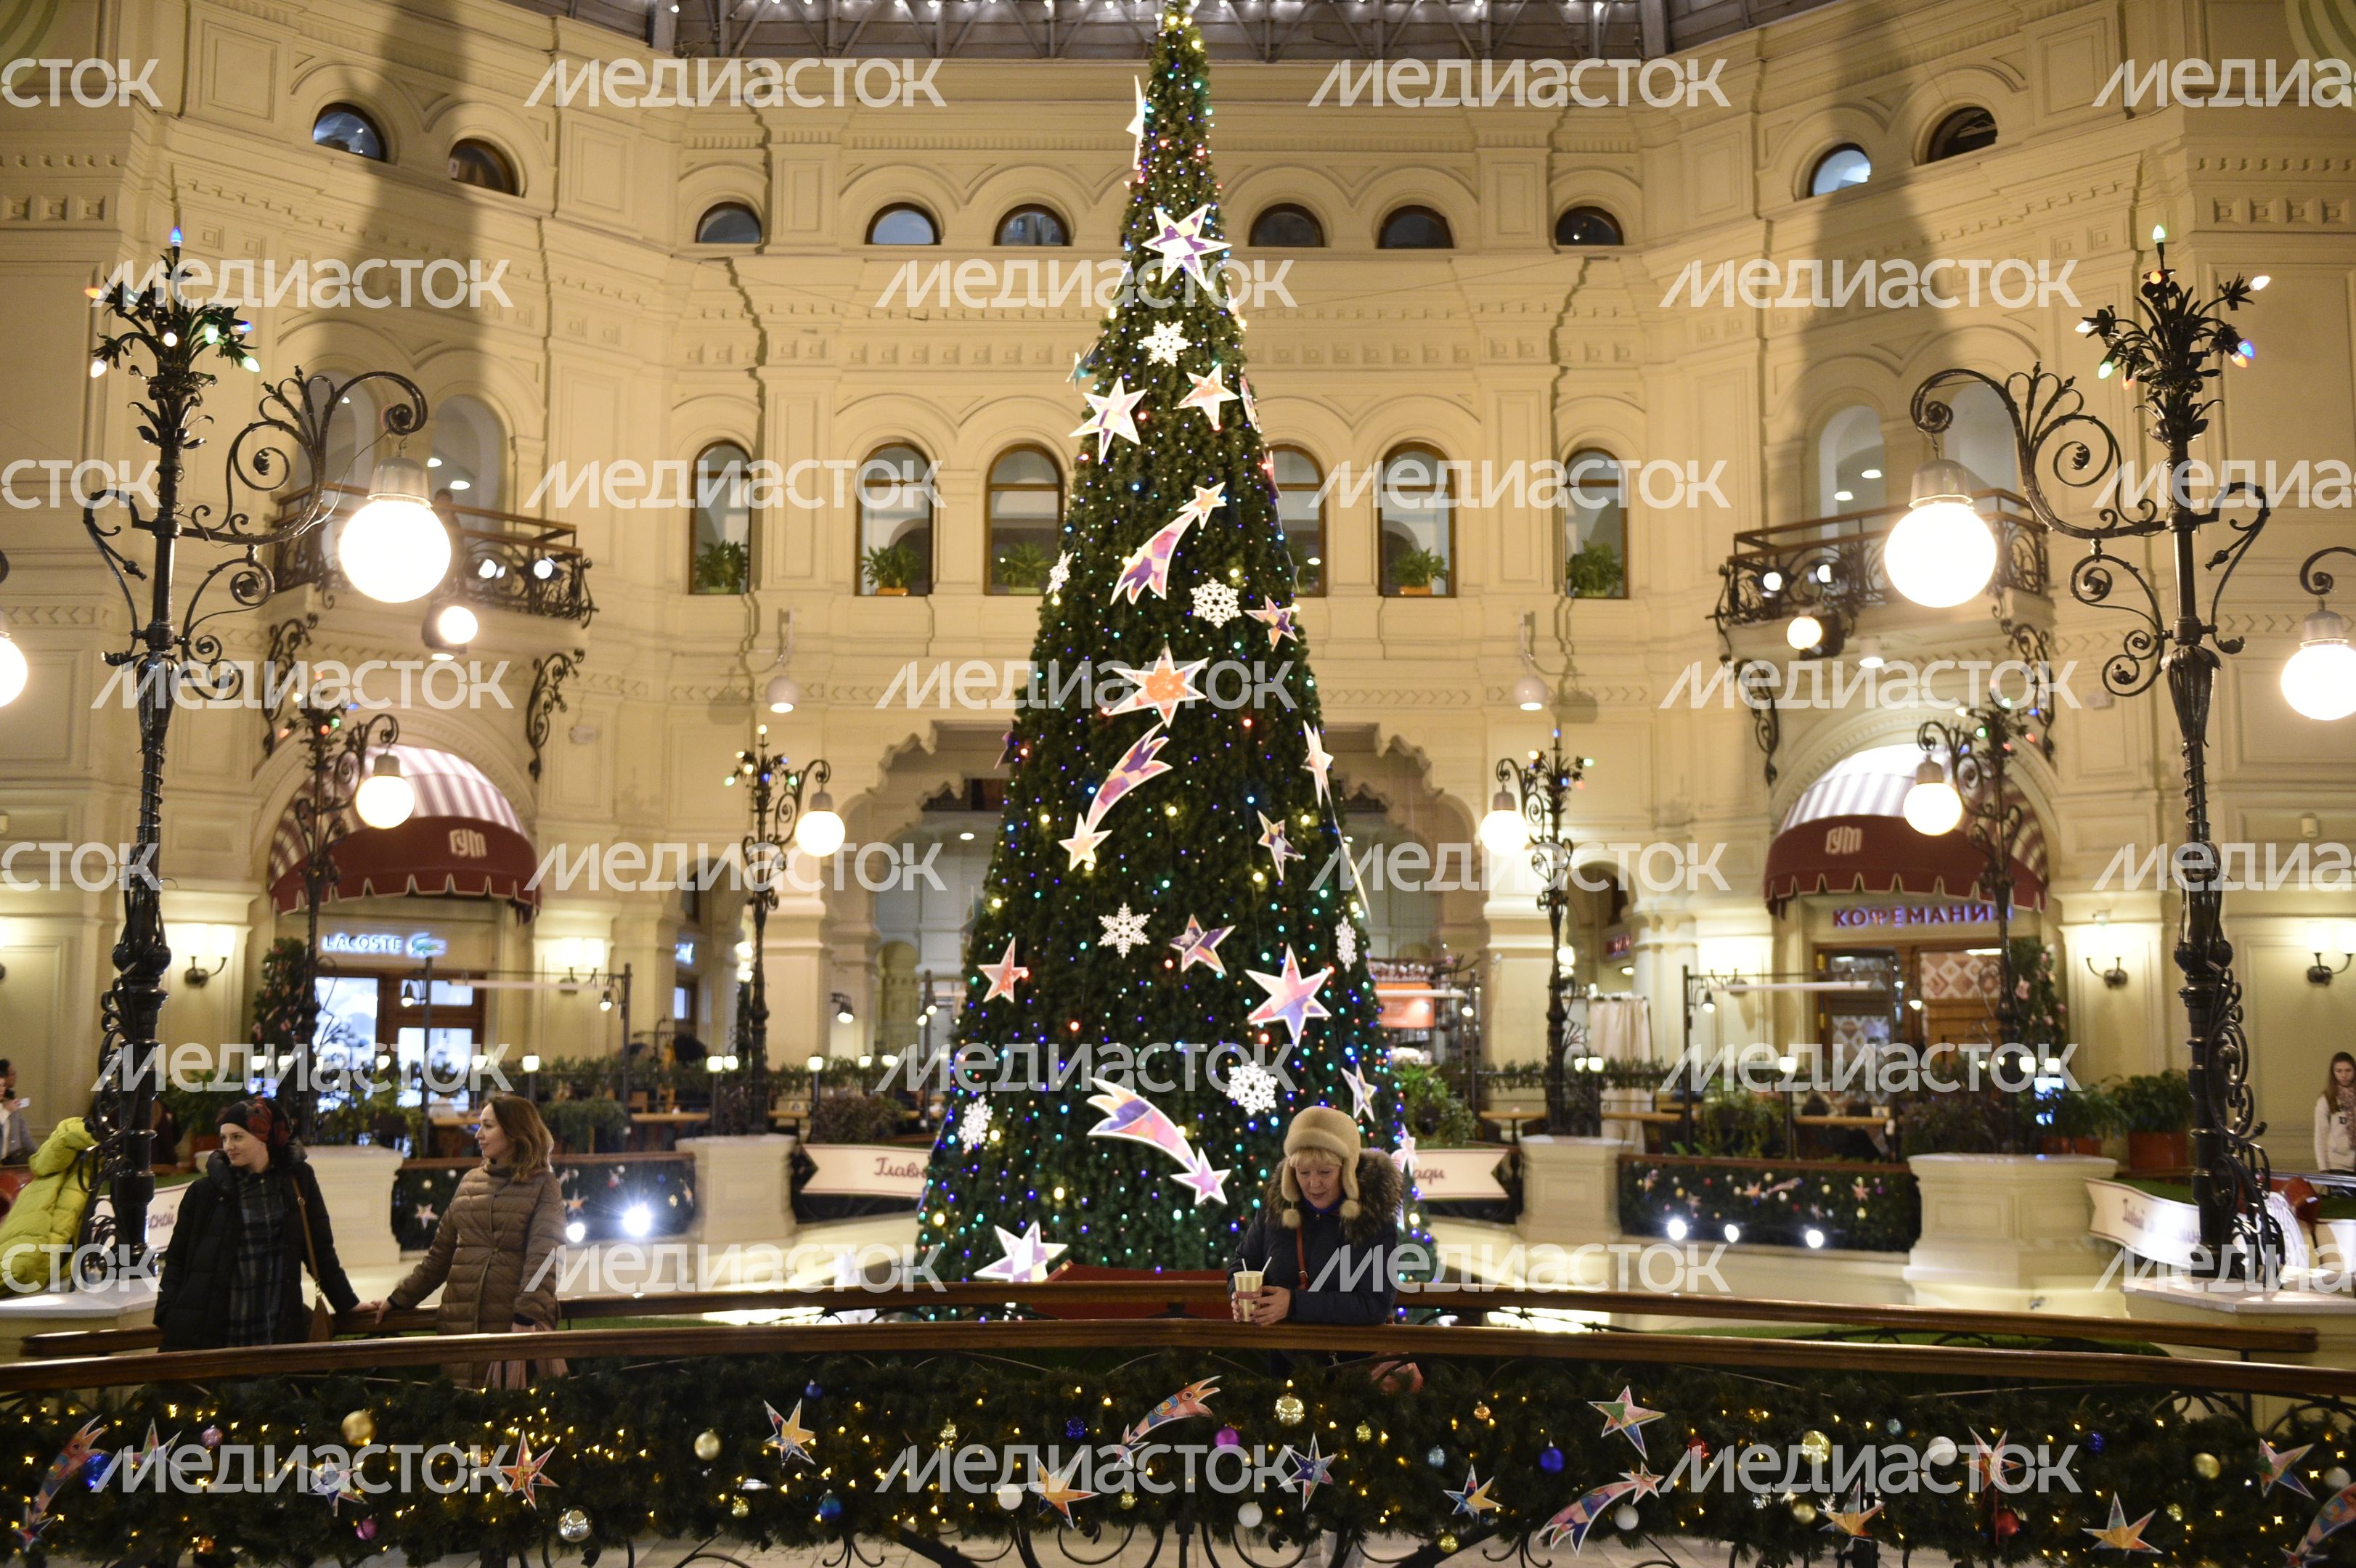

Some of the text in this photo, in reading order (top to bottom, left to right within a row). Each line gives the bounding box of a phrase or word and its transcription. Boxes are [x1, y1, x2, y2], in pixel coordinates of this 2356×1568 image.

[1832, 904, 2013, 928] КОФЕМАНИ
[324, 933, 402, 954] LACOSTE
[1413, 1168, 1446, 1185] ади
